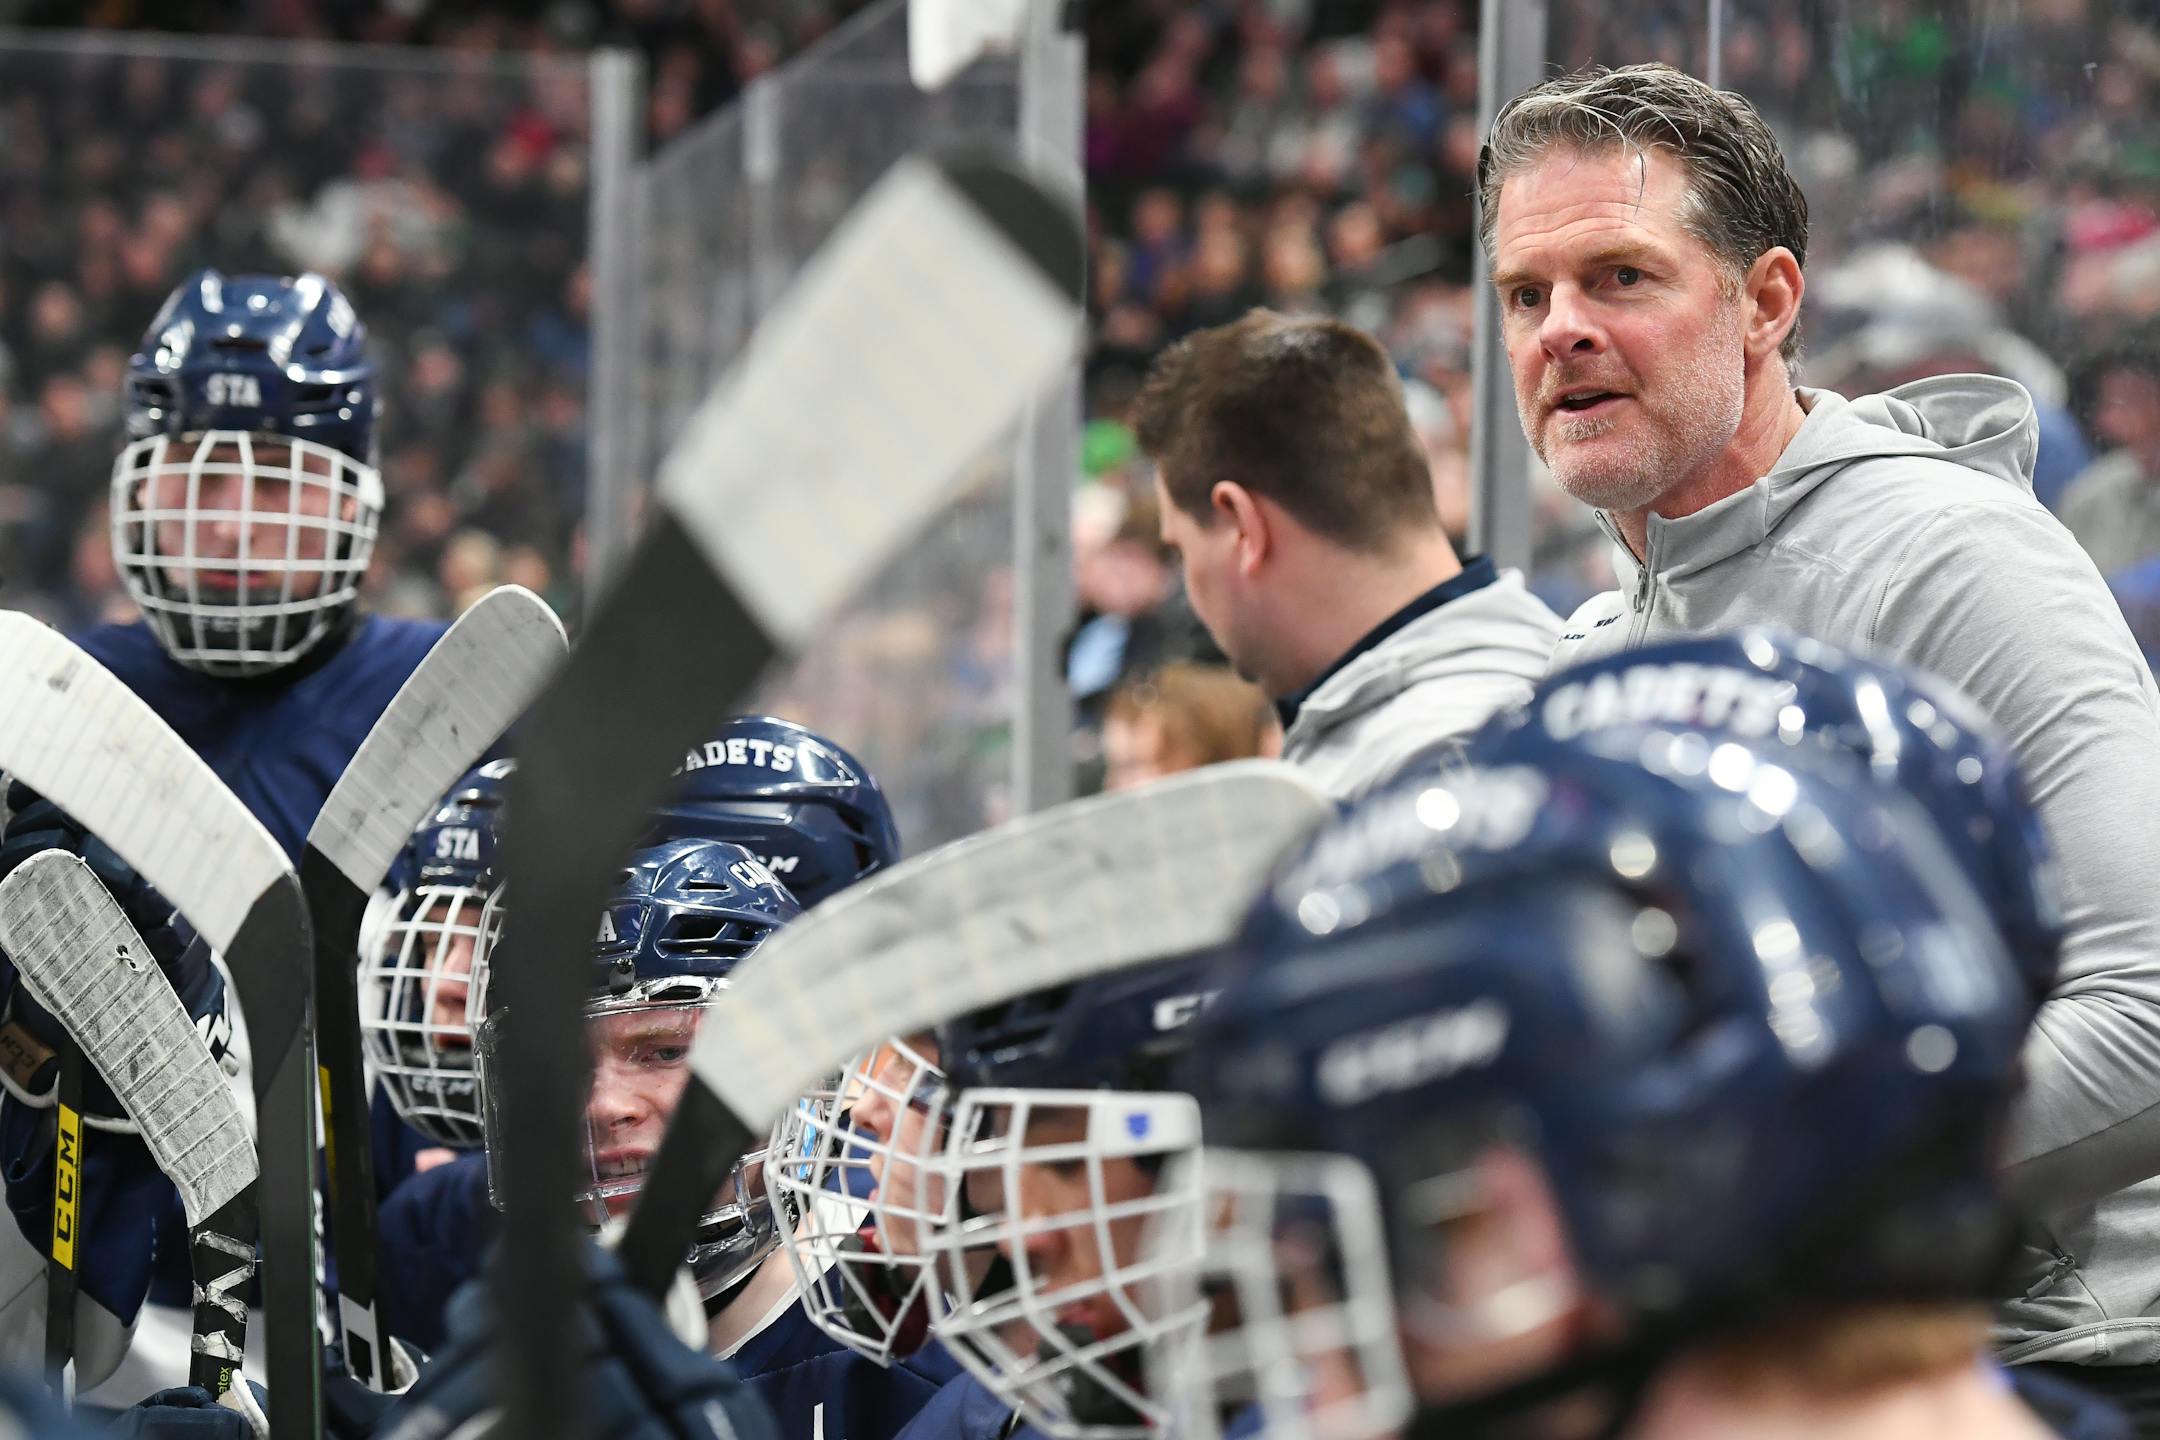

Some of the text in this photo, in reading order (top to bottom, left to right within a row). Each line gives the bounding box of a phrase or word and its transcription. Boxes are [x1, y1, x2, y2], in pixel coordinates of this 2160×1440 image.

[207, 373, 261, 407] STA
[436, 827, 479, 860] STA
[55, 1127, 76, 1243] CCM
